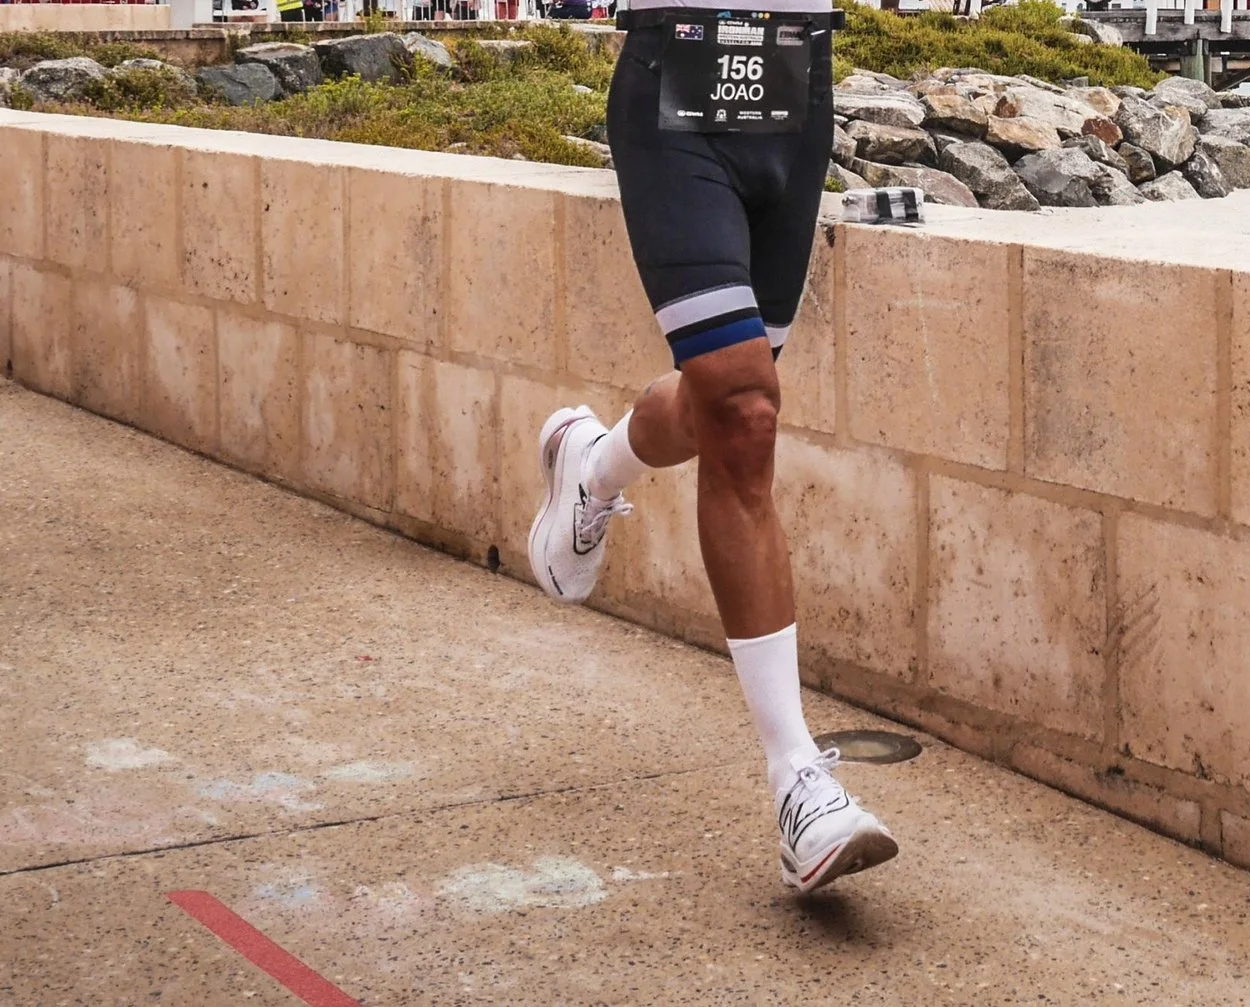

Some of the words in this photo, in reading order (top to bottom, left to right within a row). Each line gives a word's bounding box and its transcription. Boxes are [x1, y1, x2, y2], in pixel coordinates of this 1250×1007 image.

[718, 25, 765, 36] IRONMAN
[717, 54, 764, 80] 156
[710, 83, 764, 101] JOAO
